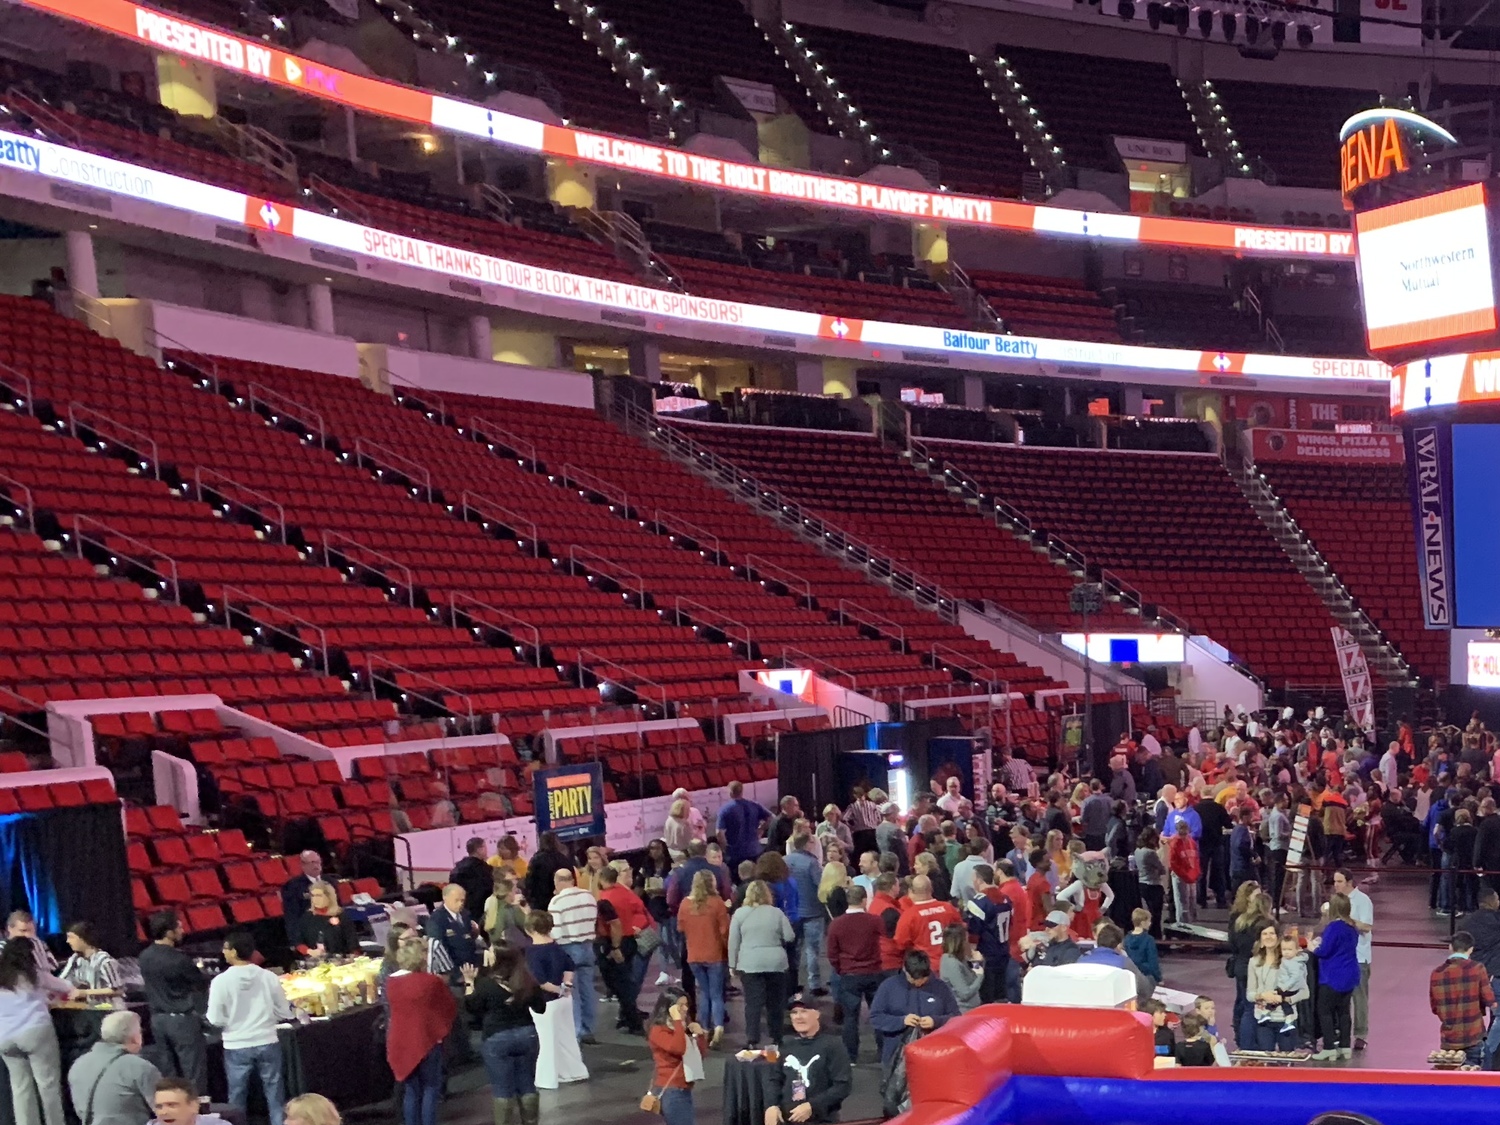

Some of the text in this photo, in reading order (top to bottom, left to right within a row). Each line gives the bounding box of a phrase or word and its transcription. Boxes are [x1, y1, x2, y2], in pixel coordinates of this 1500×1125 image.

[136, 8, 344, 95] PRESENTED BY PNC
[51, 147, 154, 196] Construction
[575, 132, 992, 222] WELCOME TO THE HOLT BROTHERS PLAYOFF PARTY!
[1234, 227, 1352, 254] PRESENTED BY
[1400, 247, 1475, 272] Northwestern
[363, 229, 743, 324] SPECIAL THANKS TO OUR BLOCK THAT KICK SPONSORS!
[1402, 271, 1440, 292] Mutual
[943, 330, 990, 351] Balfour
[995, 336, 1038, 359] Beatty
[1312, 360, 1373, 378] SPECIAL
[1309, 402, 1339, 420] THE
[1297, 446, 1391, 458] DELICIOUSNESS
[1341, 434, 1378, 446] PIZZA
[1380, 435, 1389, 446] &
[1417, 433, 1441, 514] WRAL
[1425, 522, 1447, 622] NEWS
[553, 785, 592, 819] PARTY
[928, 920, 943, 946] 2
